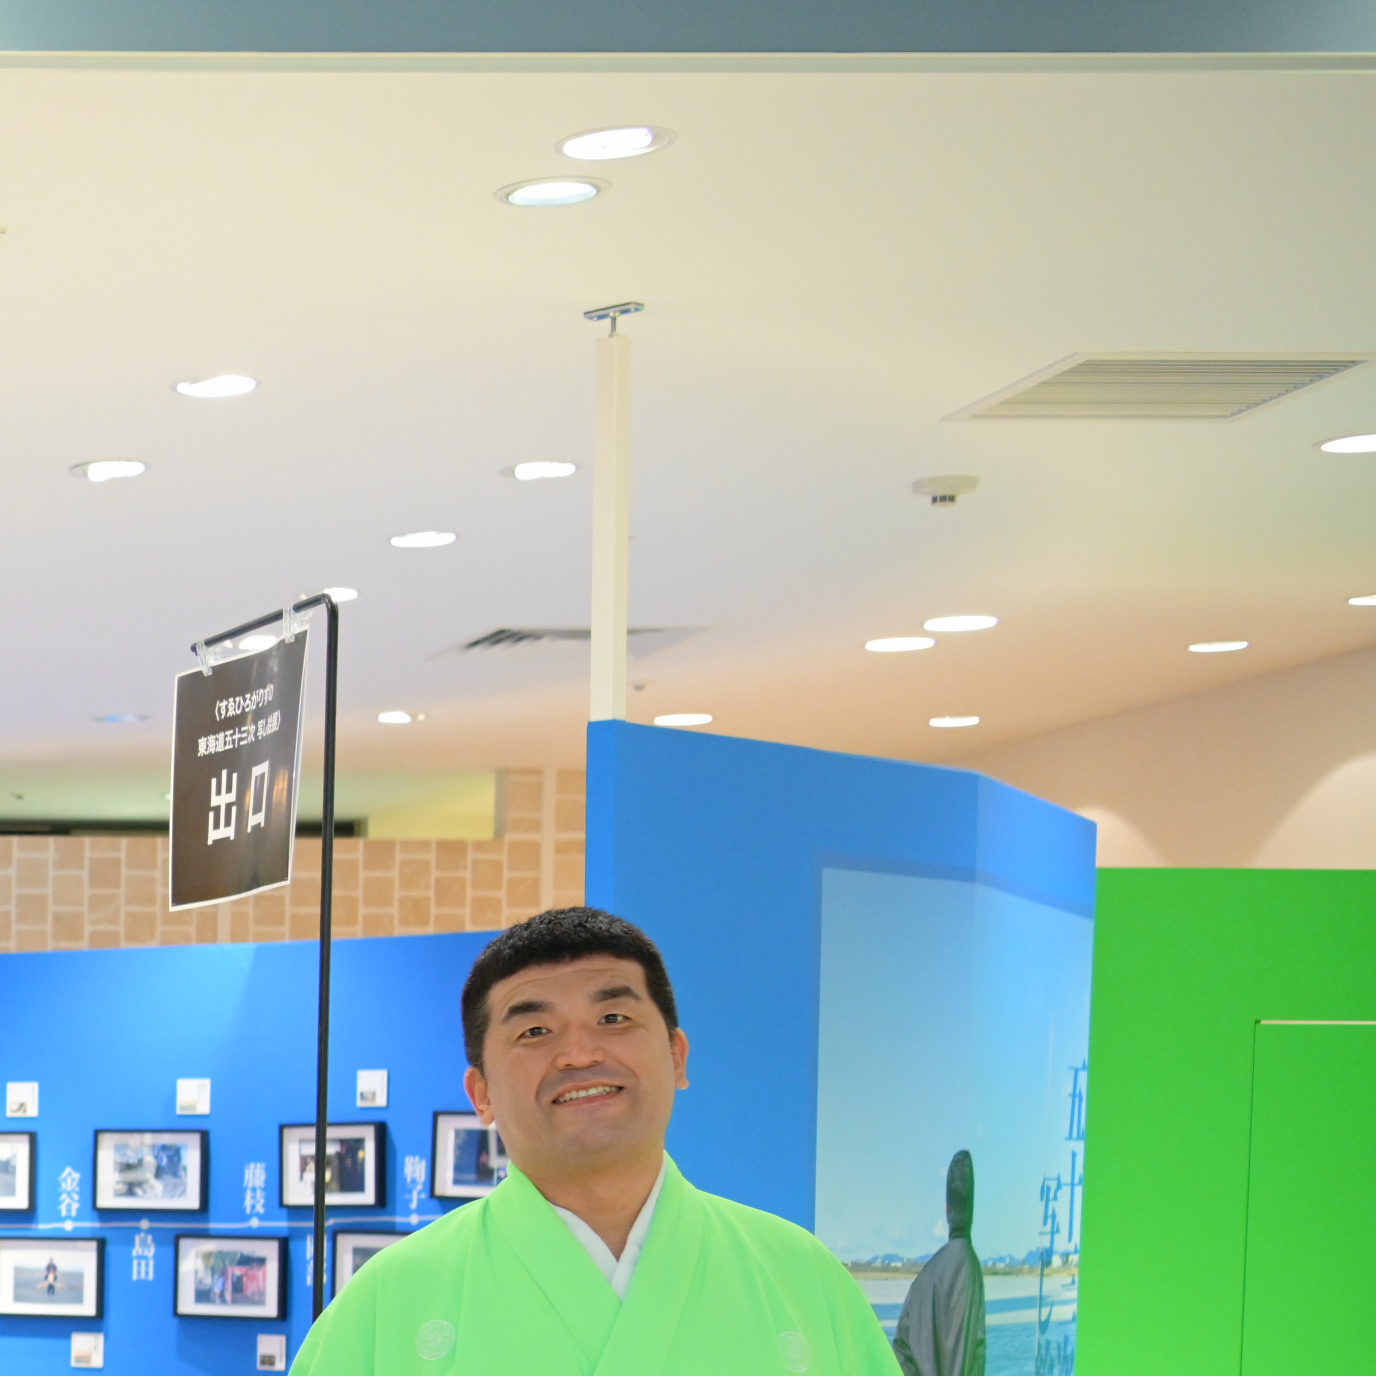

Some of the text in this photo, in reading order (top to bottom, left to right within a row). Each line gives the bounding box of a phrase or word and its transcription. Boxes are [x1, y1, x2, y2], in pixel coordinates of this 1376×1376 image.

[198, 724, 256, 758] 東海道五十三次
[207, 759, 270, 846] 出口
[57, 1166, 81, 1218] 金谷
[243, 1162, 266, 1215] 藤枝
[132, 1233, 155, 1281] 島田
